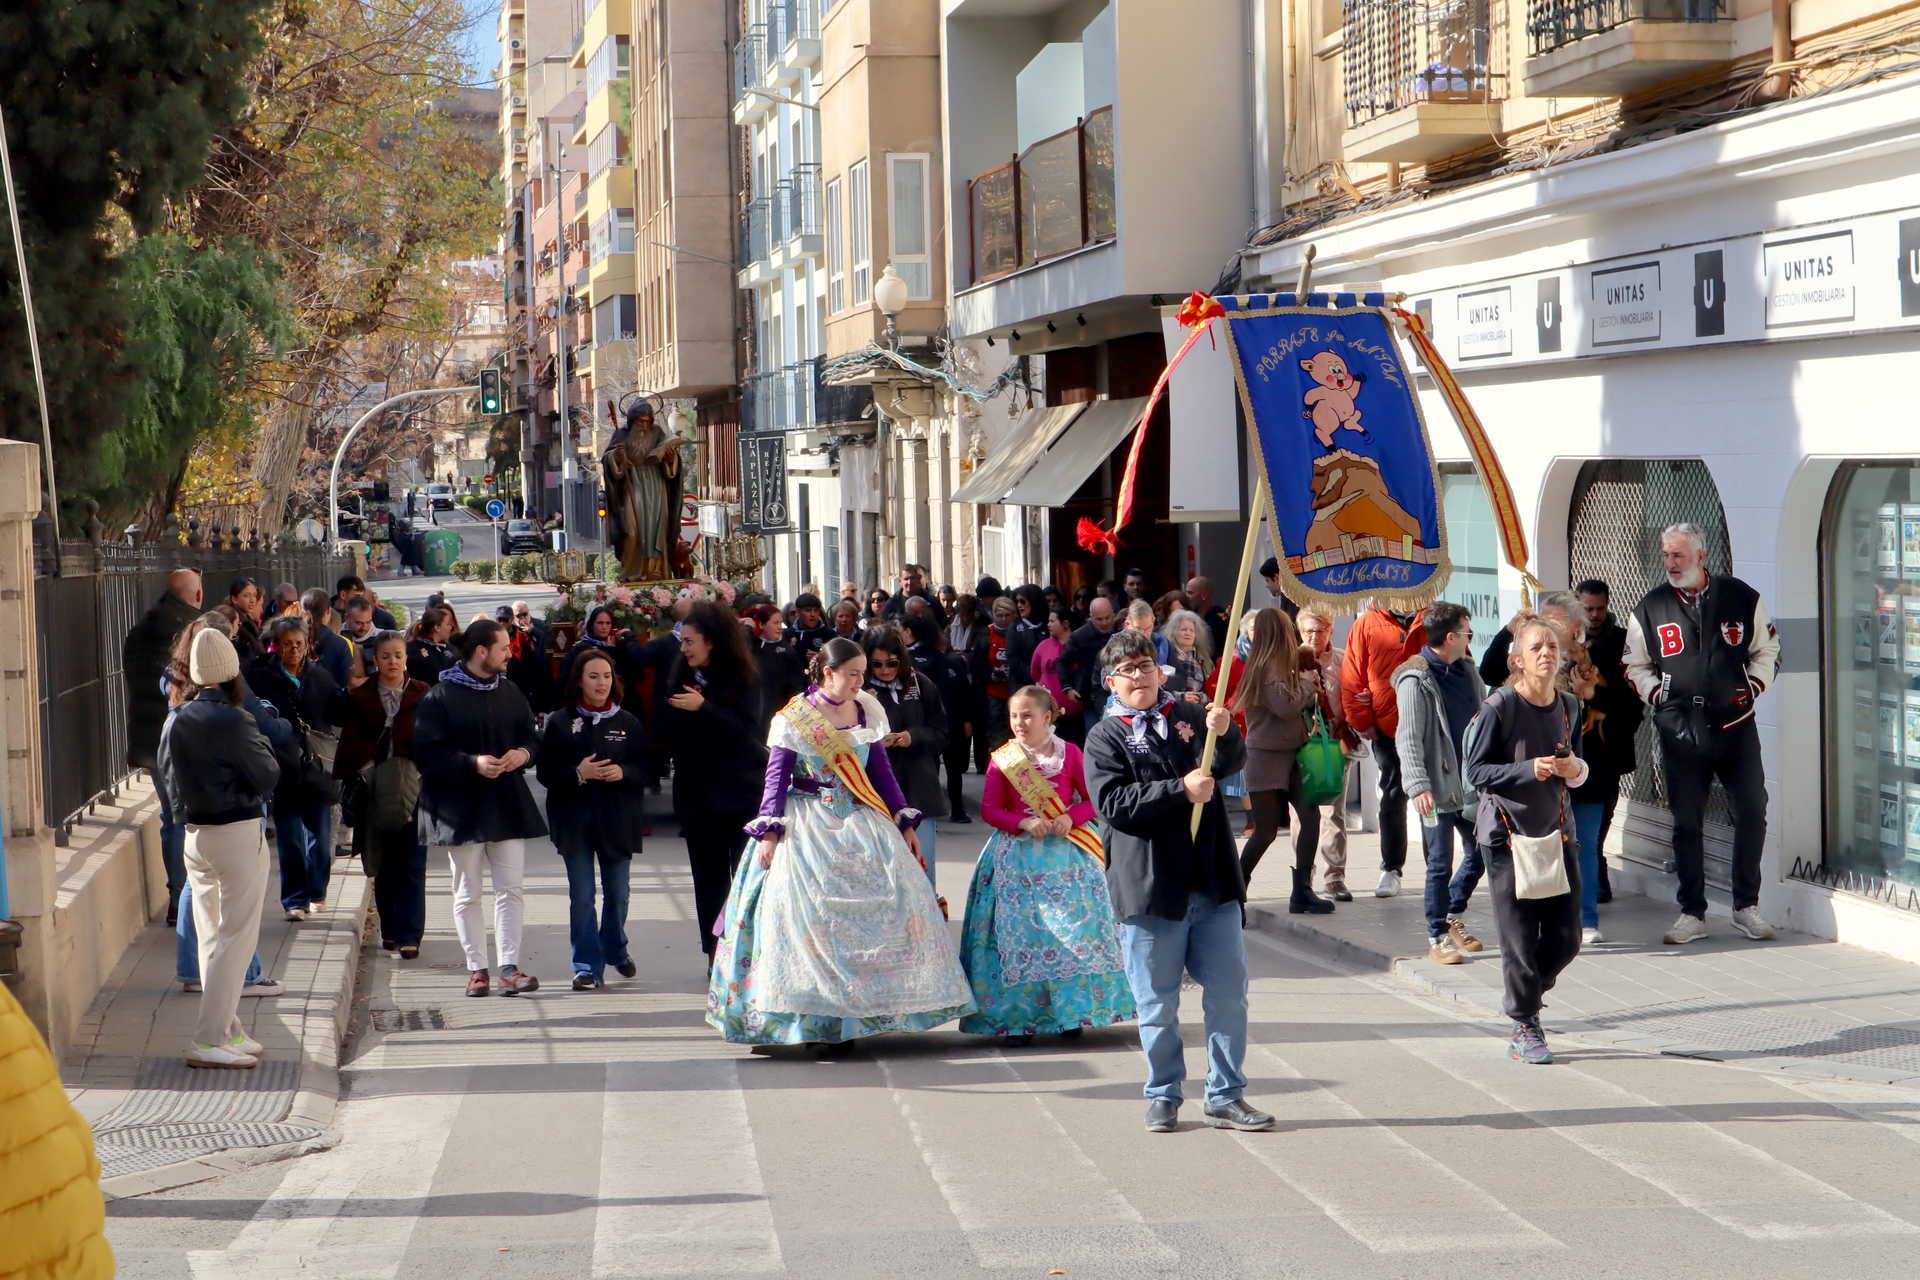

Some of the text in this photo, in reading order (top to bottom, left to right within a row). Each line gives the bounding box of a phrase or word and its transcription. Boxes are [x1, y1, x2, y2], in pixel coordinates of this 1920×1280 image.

[1784, 255, 1834, 281] UNITAS
[1607, 283, 1645, 305] UNITAS
[1703, 278, 1714, 309] U
[1469, 304, 1499, 324] UNITAS
[1543, 301, 1553, 329] U
[749, 441, 756, 457] LA
[750, 462, 759, 508] PLAZA
[1461, 591, 1500, 619] UNITA
[1657, 622, 1685, 658] B
